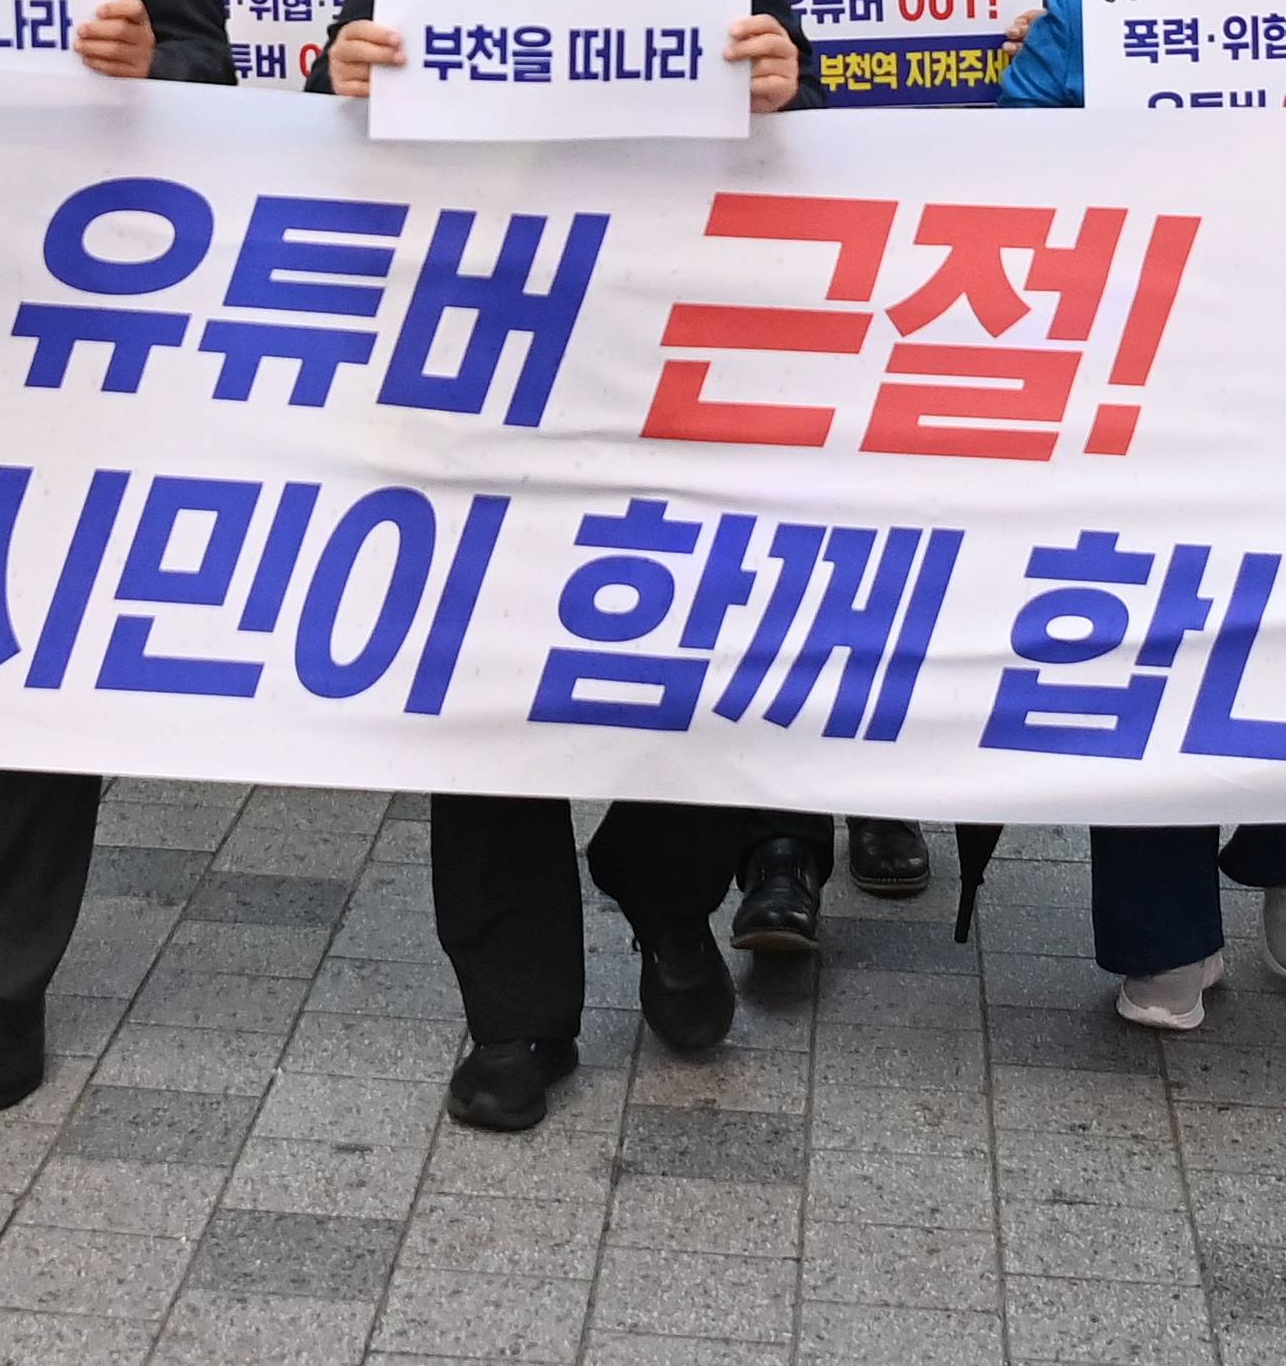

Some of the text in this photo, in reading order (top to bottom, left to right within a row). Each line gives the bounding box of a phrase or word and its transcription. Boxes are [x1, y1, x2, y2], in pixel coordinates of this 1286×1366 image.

[423, 24, 704, 84] 부천을 떠나라
[820, 51, 899, 92] 부천역
[11, 177, 610, 430] 유튜버
[637, 191, 1202, 462] 근절!
[527, 498, 966, 744] 함께
